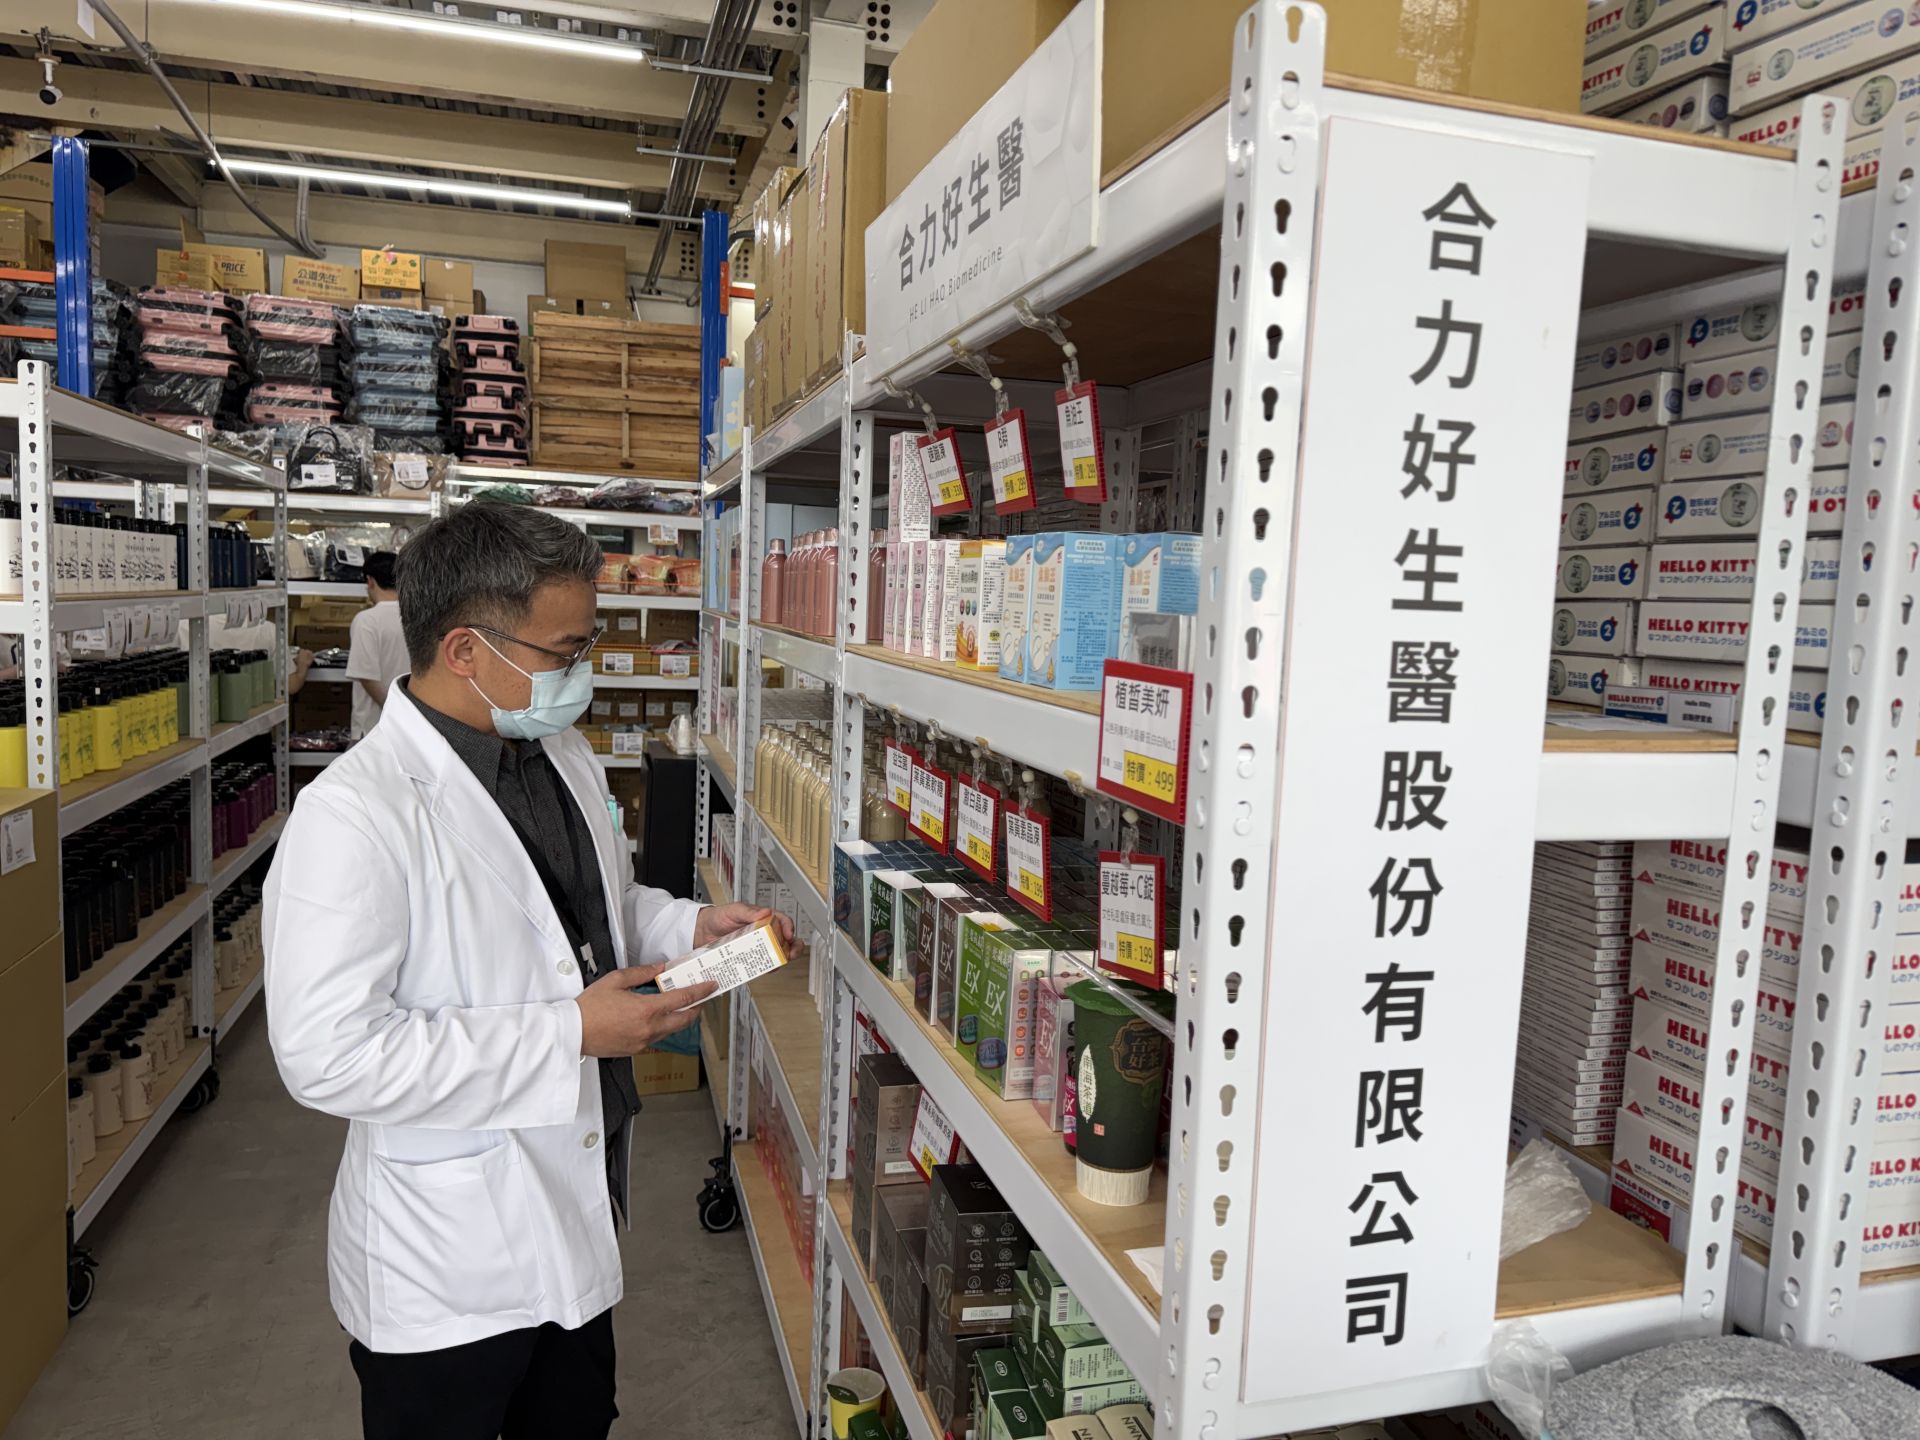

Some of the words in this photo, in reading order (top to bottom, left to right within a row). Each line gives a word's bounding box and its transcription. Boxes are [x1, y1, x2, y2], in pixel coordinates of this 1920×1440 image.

[1583, 64, 1624, 91] KITTY
[899, 116, 1024, 291] 合力好生醫
[221, 261, 245, 273] PRICE
[298, 269, 338, 285] 公道先生
[908, 304, 918, 324] HE
[920, 298, 928, 316] LI
[929, 283, 946, 311] HAO
[949, 244, 1003, 297] Biomedicine
[1612, 453, 1634, 463] アルミの
[1599, 511, 1621, 519] アルミの
[1592, 565, 1615, 573] アルミの
[1659, 560, 1706, 573] HELLO
[1577, 620, 1597, 628] アルミの
[1648, 618, 1693, 633] HELLO
[1698, 620, 1749, 636] KITTY
[1567, 671, 1588, 680] アルミの
[1649, 675, 1690, 690] HELLO
[1694, 680, 1740, 695] KITTY
[1608, 694, 1630, 703] HELLO
[1631, 696, 1656, 705] KITTY
[1343, 181, 1497, 1347] 合力好生醫股份有限公司
[872, 903, 882, 927] EX
[921, 923, 933, 955] EX
[940, 941, 954, 974] EX
[964, 960, 981, 995] EX
[1665, 957, 1713, 988] HELL
[985, 980, 1006, 1017] EX
[1757, 991, 1795, 1018] TTY
[1040, 1019, 1055, 1059] EX
[1884, 1024, 1915, 1041] LLO
[1658, 1076, 1700, 1109] HELL
[1877, 1094, 1916, 1111] ELLO
[1597, 1108, 1616, 1116] HELL
[1649, 1135, 1693, 1171] HELL
[1649, 1154, 1691, 1184] なつかしの
[1871, 1159, 1906, 1177] LLO
[1615, 1173, 1638, 1192] HELLO
[1638, 1182, 1662, 1204] KITTY
[1738, 1180, 1776, 1214] TTY
[1863, 1224, 1894, 1242] LLO
